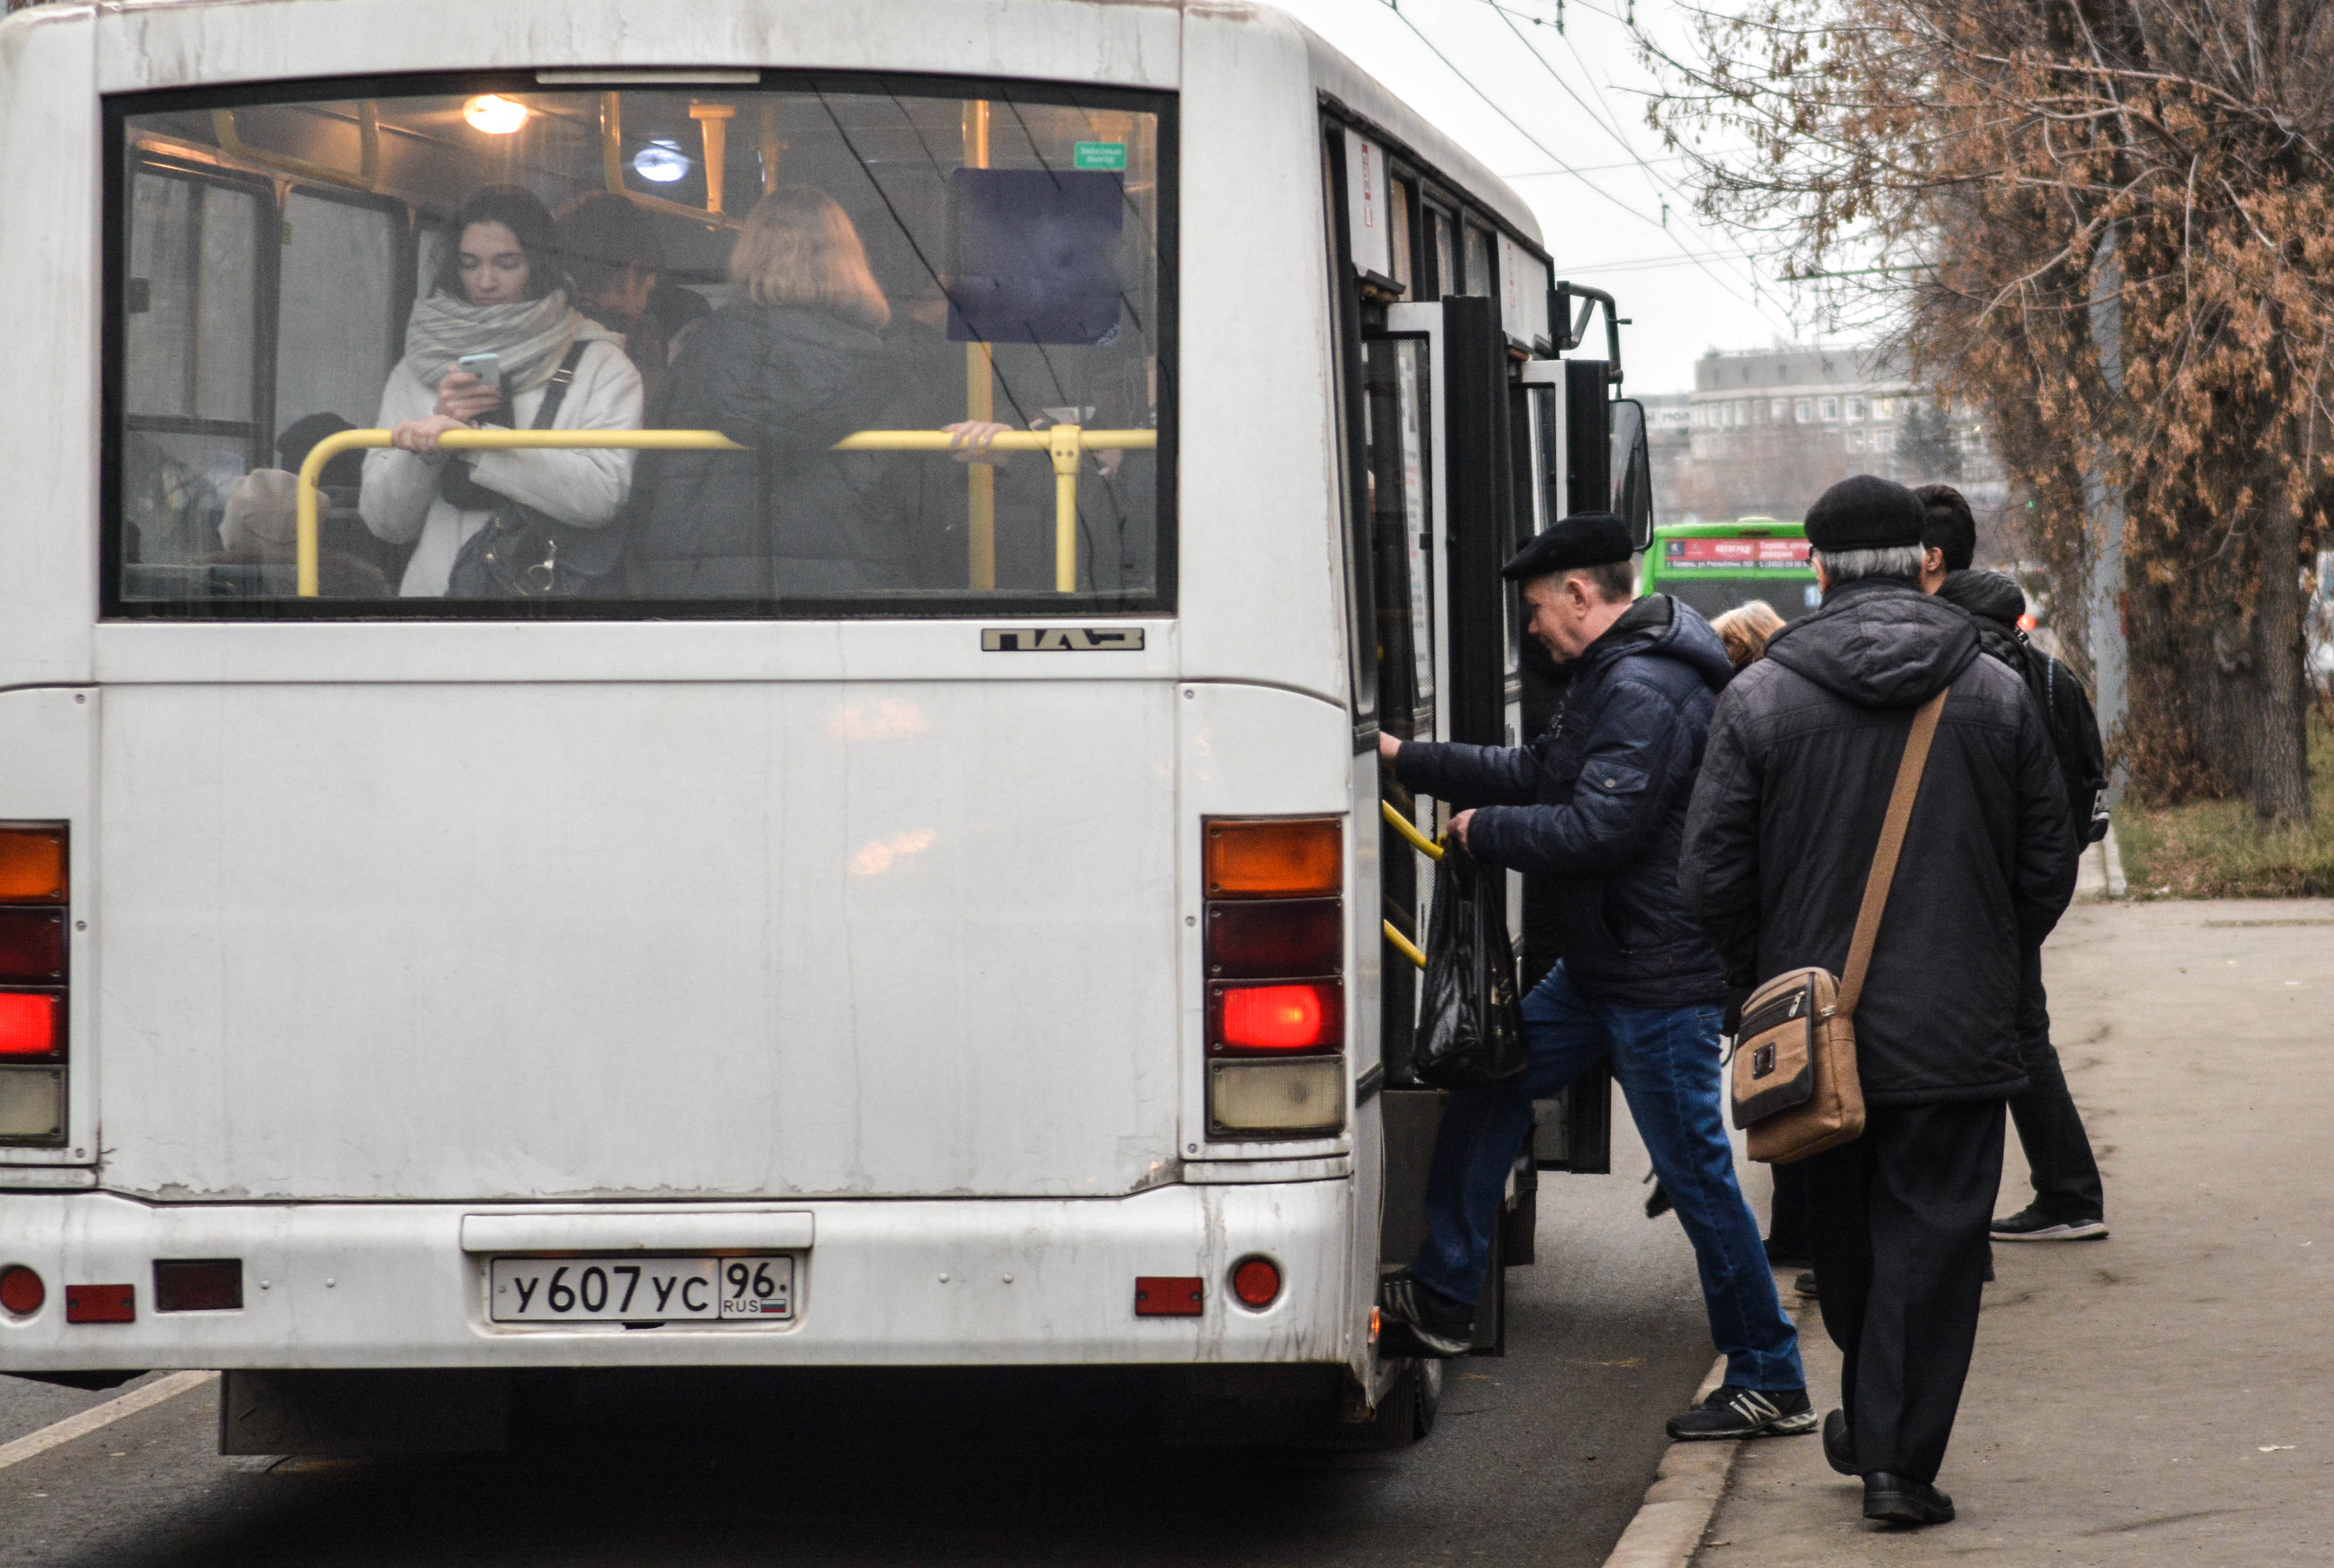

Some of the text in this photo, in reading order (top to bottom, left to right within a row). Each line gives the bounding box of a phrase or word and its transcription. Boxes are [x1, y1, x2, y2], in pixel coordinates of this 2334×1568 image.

[514, 1262, 776, 1313] У607УС 96
[724, 1299, 758, 1313] RUS
